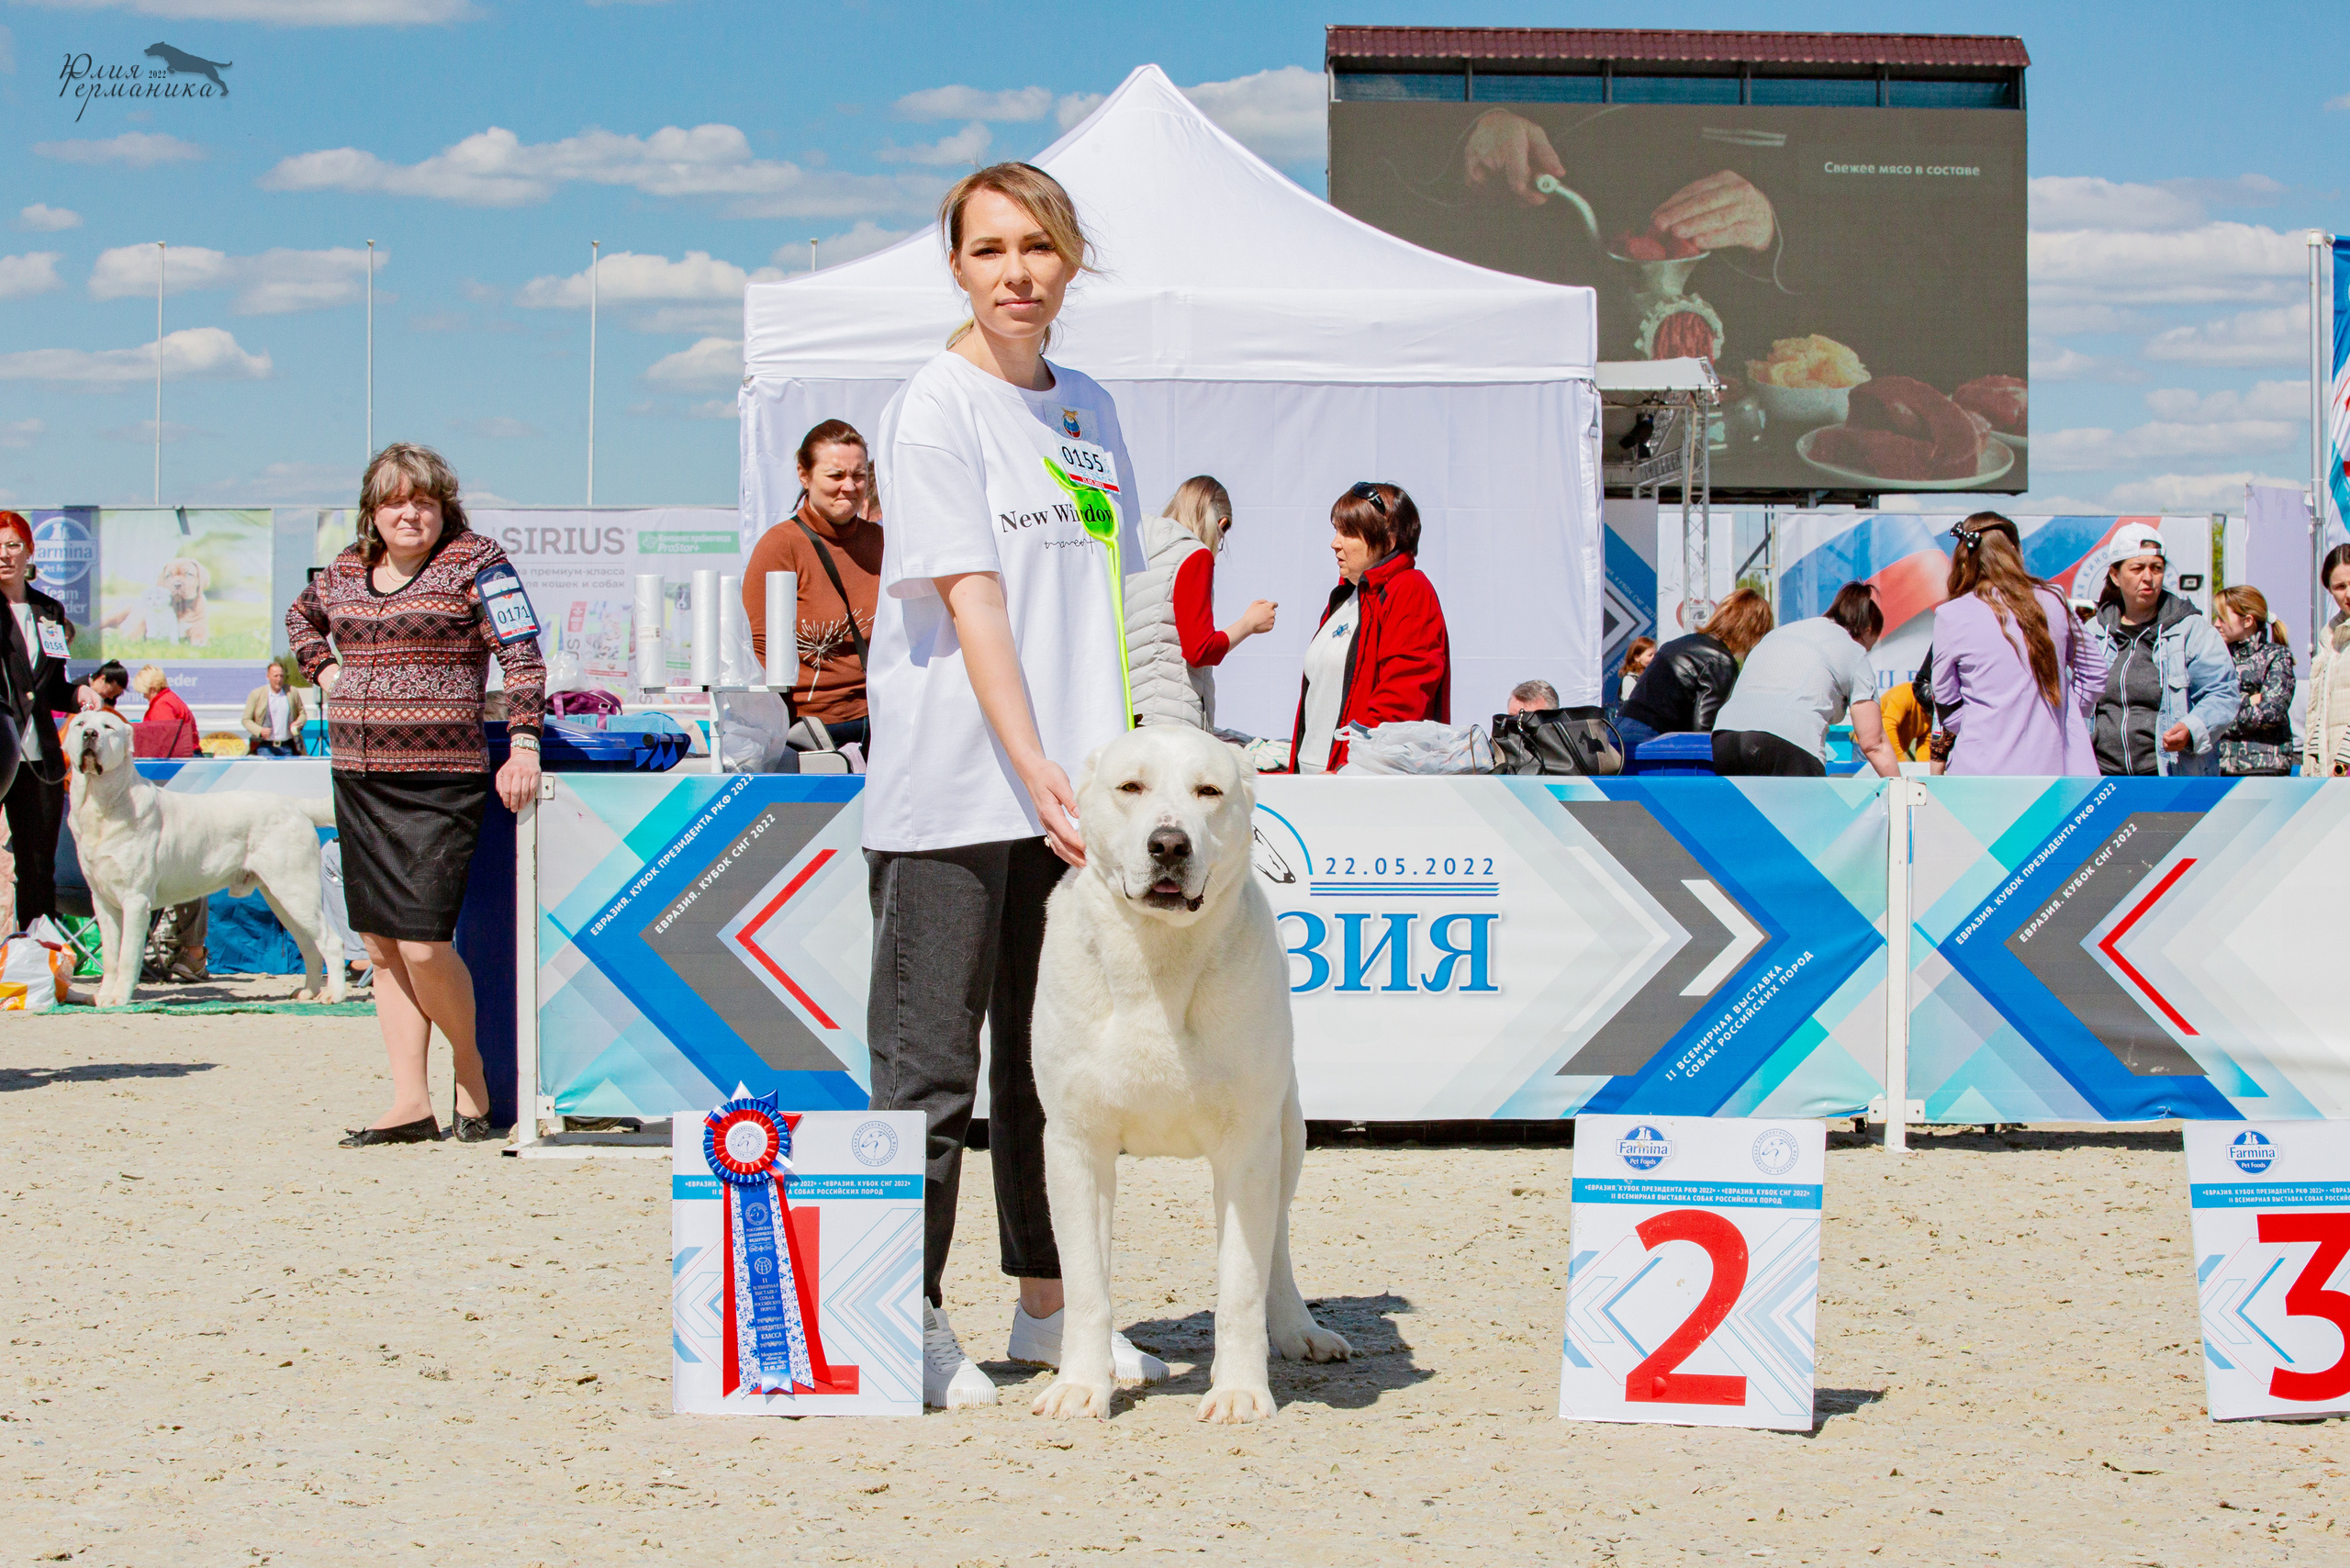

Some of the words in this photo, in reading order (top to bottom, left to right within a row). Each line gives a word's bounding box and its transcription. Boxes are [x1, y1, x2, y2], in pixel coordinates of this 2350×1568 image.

[1824, 162, 1875, 174] Свежее
[1878, 164, 1912, 175] мясо
[1915, 165, 1923, 175] в
[1926, 165, 1981, 176] составе
[1061, 446, 1104, 473] 0155
[999, 510, 1048, 532] New
[502, 527, 625, 554] SIRIUS
[38, 544, 93, 559] armina
[531, 567, 625, 577] премиум-класса
[41, 586, 79, 600] Team
[543, 580, 578, 588] кошек
[582, 580, 589, 588] и
[592, 579, 625, 588] собак
[498, 605, 531, 624] 0171
[44, 640, 64, 651] 0158
[590, 896, 632, 936] ЕВРАЗИЯ.
[629, 867, 660, 897] КУБОК
[657, 813, 713, 868] ПРЕЗИДЕНТА
[711, 794, 732, 815] РКФ
[730, 772, 755, 796] 2022
[1325, 857, 1494, 876] 22.05.2022
[1954, 905, 1997, 946] ЕВРАЗИЯ.
[1994, 875, 2025, 907] КУБОК
[2021, 823, 2077, 879] ПРЕЗИДЕНТА
[2074, 803, 2095, 824] РКФ
[2093, 782, 2117, 806] 2022
[655, 890, 701, 935] ЕВРАЗИЯ.
[699, 857, 733, 890] КУБОК
[731, 836, 751, 858] СНГ
[750, 813, 776, 839] 2022
[2019, 899, 2065, 944] ЕВРАЗИЯ.
[2062, 865, 2096, 900] КУБОК
[2094, 846, 2114, 868] СНГ
[2112, 823, 2138, 849] 2022
[1277, 910, 1500, 993] ЗИЯ
[1675, 1013, 1734, 1070] ВСЕМИРНАЯ
[1732, 964, 1784, 1015] ВЫСТАВКА
[1685, 1046, 1718, 1079] СОБАК
[1717, 983, 1781, 1047] РОССИЙСКИХ
[1779, 950, 1815, 986] ПОРОД
[1619, 1141, 1668, 1155] Farmina
[2229, 1147, 2276, 1159] Farmina
[816, 1187, 859, 1195] РОССИЙСКИХ
[1641, 1185, 1683, 1193] ПРЕЗИДЕНТА
[1715, 1194, 1758, 1204] РОССИЙСКИХ
[1759, 1196, 1783, 1204] ПОРОД
[1625, 1209, 1749, 1406] 2
[2256, 1213, 2350, 1402] 3
